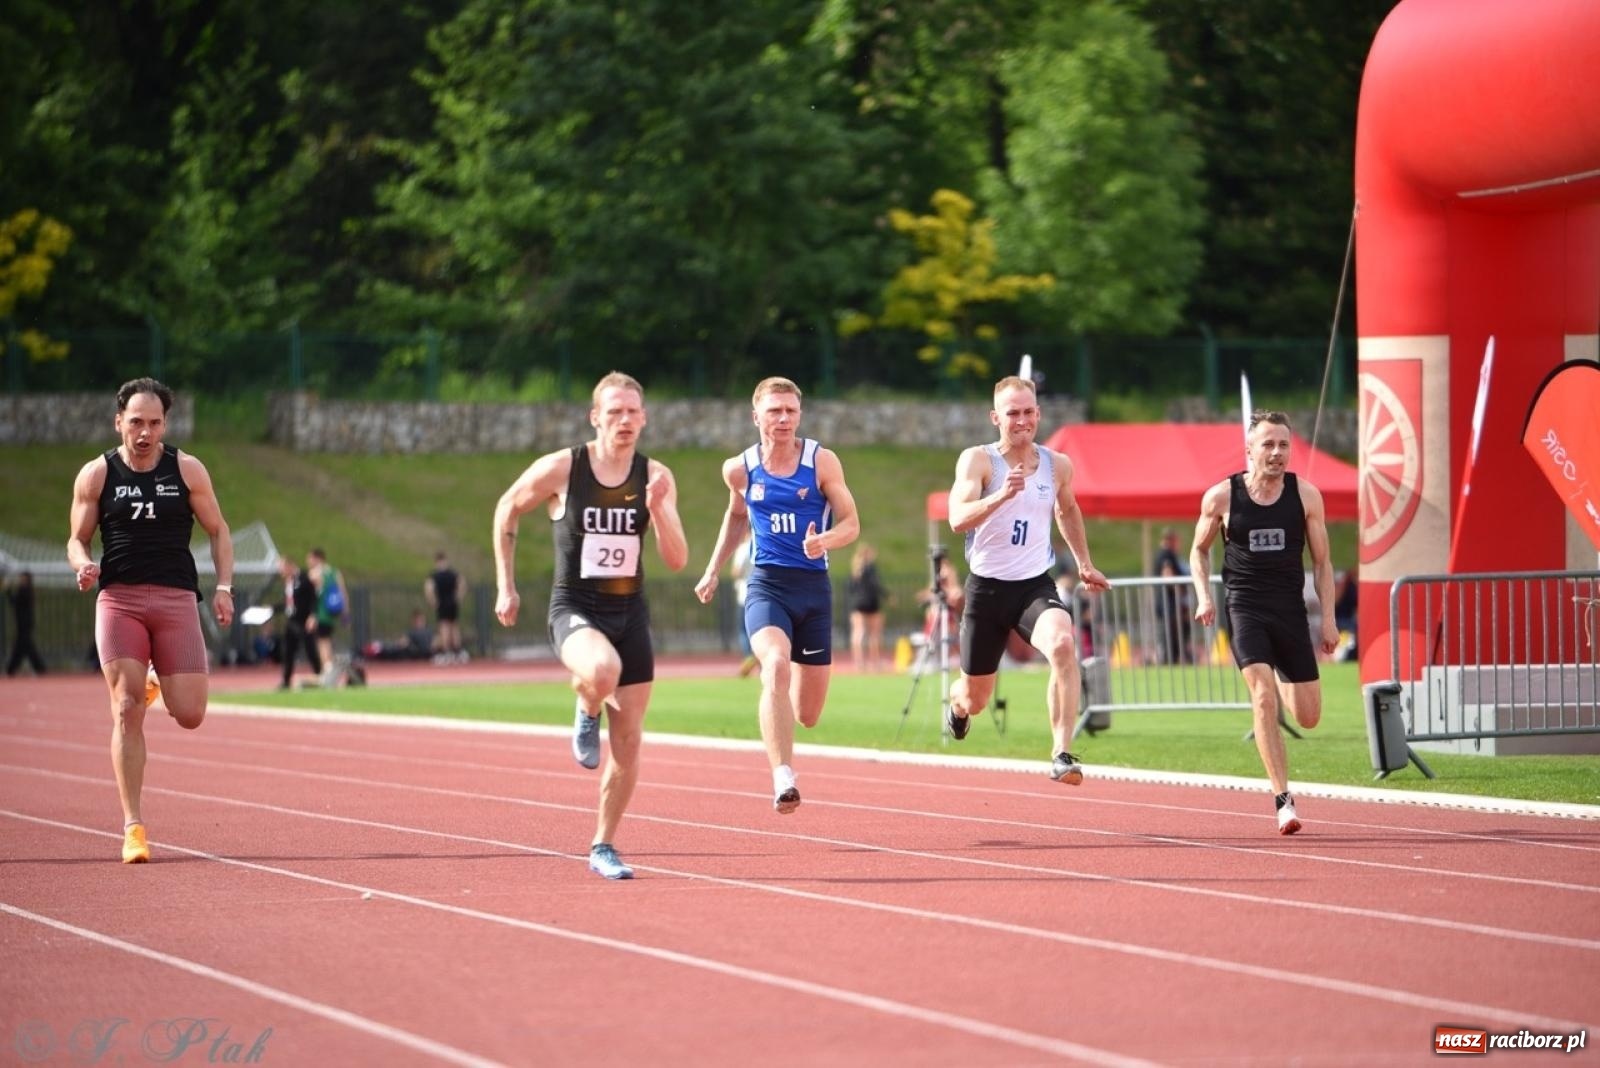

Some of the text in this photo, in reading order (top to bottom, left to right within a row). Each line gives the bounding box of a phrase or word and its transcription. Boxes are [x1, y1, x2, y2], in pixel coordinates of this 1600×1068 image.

[130, 502, 156, 520] 71
[583, 506, 637, 534] ELITE
[770, 512, 796, 534] 311
[1011, 519, 1029, 546] 51
[1250, 533, 1281, 546] 111
[597, 547, 626, 568] 29
